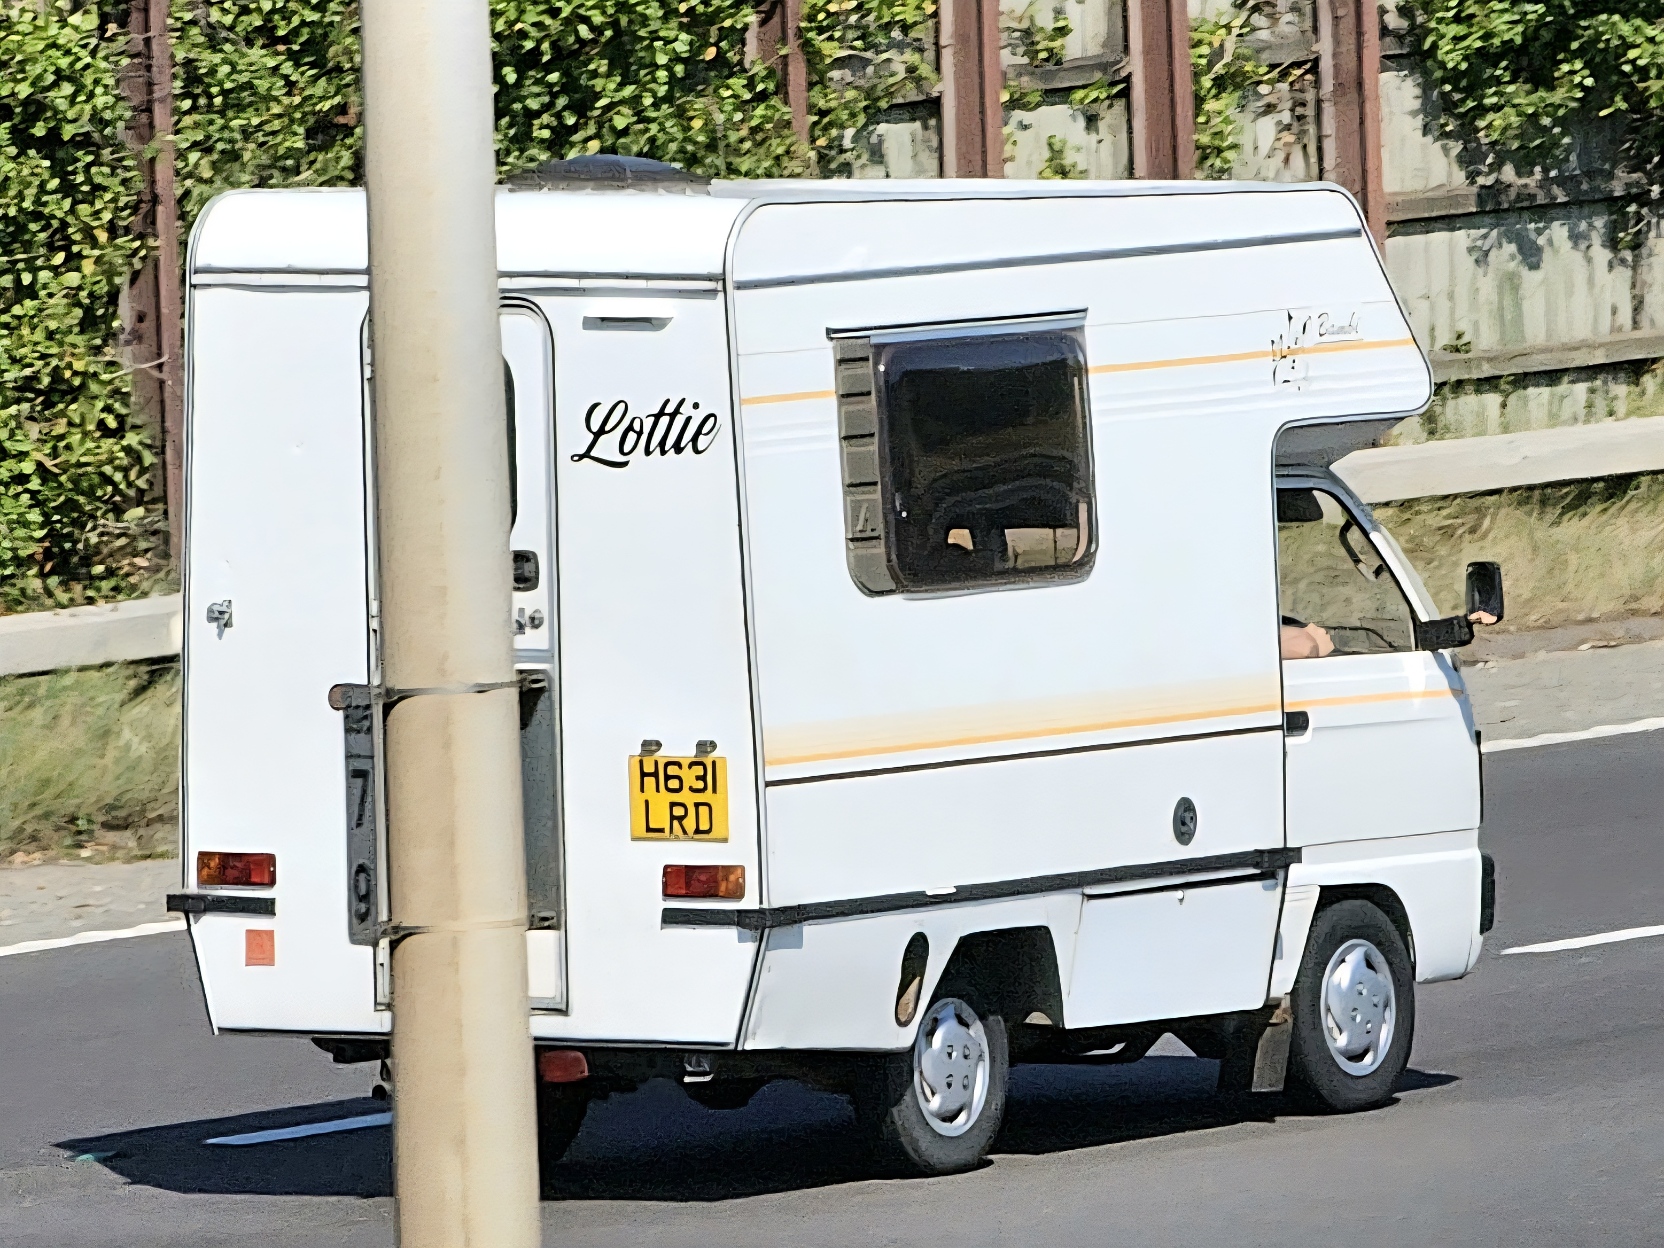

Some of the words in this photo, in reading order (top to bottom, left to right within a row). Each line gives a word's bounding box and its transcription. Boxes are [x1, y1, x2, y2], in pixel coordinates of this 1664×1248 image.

[570, 397, 722, 469] Lottie
[638, 758, 718, 794] H631
[644, 799, 713, 837] LRD
